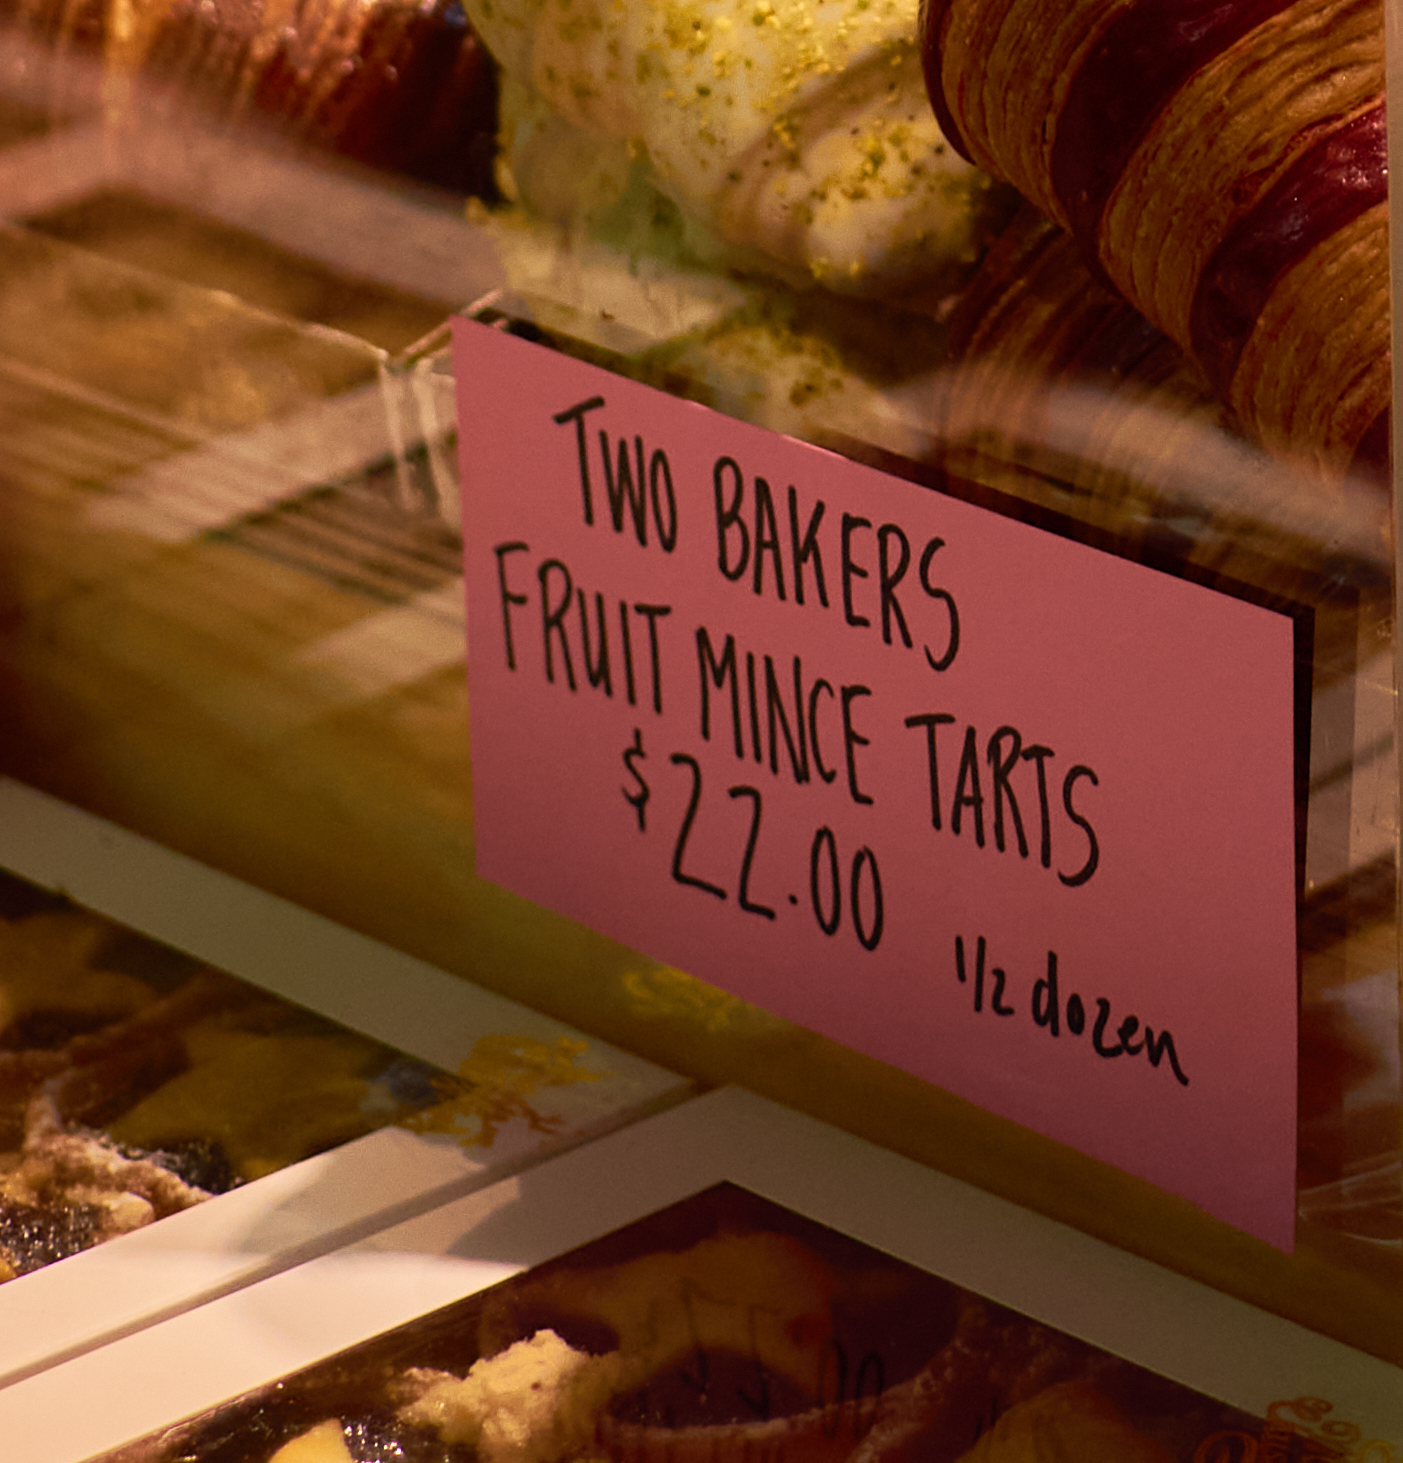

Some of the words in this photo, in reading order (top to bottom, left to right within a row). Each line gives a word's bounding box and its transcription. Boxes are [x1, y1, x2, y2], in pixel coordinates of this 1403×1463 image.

[553, 396, 677, 553] TWO
[713, 456, 961, 672] BAKERS
[494, 541, 672, 715] FRUIT
[695, 626, 875, 806] MINCE
[904, 713, 1100, 888] TARTS
[622, 728, 885, 952] $22.00
[1032, 950, 1190, 1086] dozen
